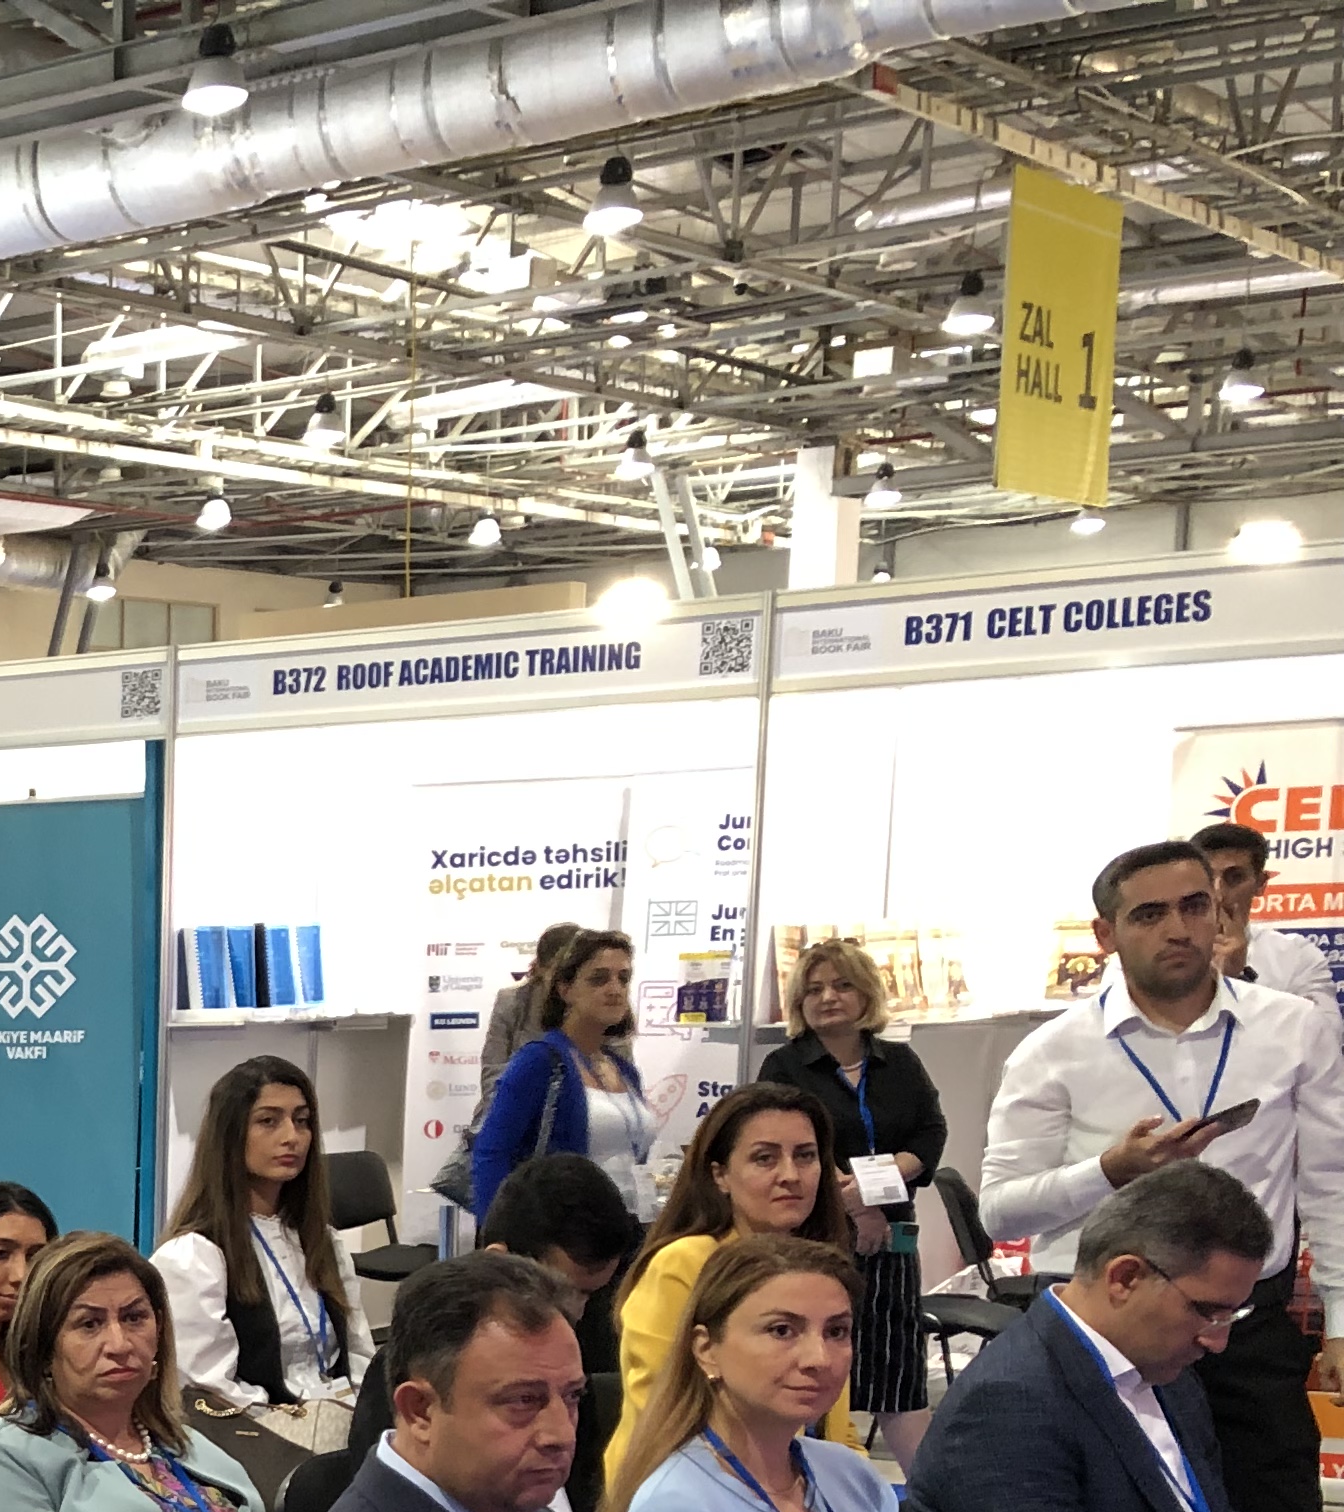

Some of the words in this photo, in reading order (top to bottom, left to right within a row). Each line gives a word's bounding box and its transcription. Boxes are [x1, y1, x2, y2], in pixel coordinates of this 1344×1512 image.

[1020, 302, 1054, 349] ZAL
[1016, 353, 1063, 403] HALL
[1078, 330, 1097, 411] 1
[904, 610, 972, 646] B371
[987, 604, 1056, 640] CELT
[1063, 589, 1213, 634] COLLEGES
[273, 666, 325, 696] B372
[337, 660, 394, 691] ROOF
[399, 651, 520, 688] ACADEMIC
[525, 641, 642, 677] TRAINING
[430, 846, 537, 869] Xaricdə
[544, 840, 628, 864] təhsili
[428, 873, 532, 900] əlçatan
[539, 867, 627, 890] edirik!
[6, 1046, 47, 1059] VAKFI
